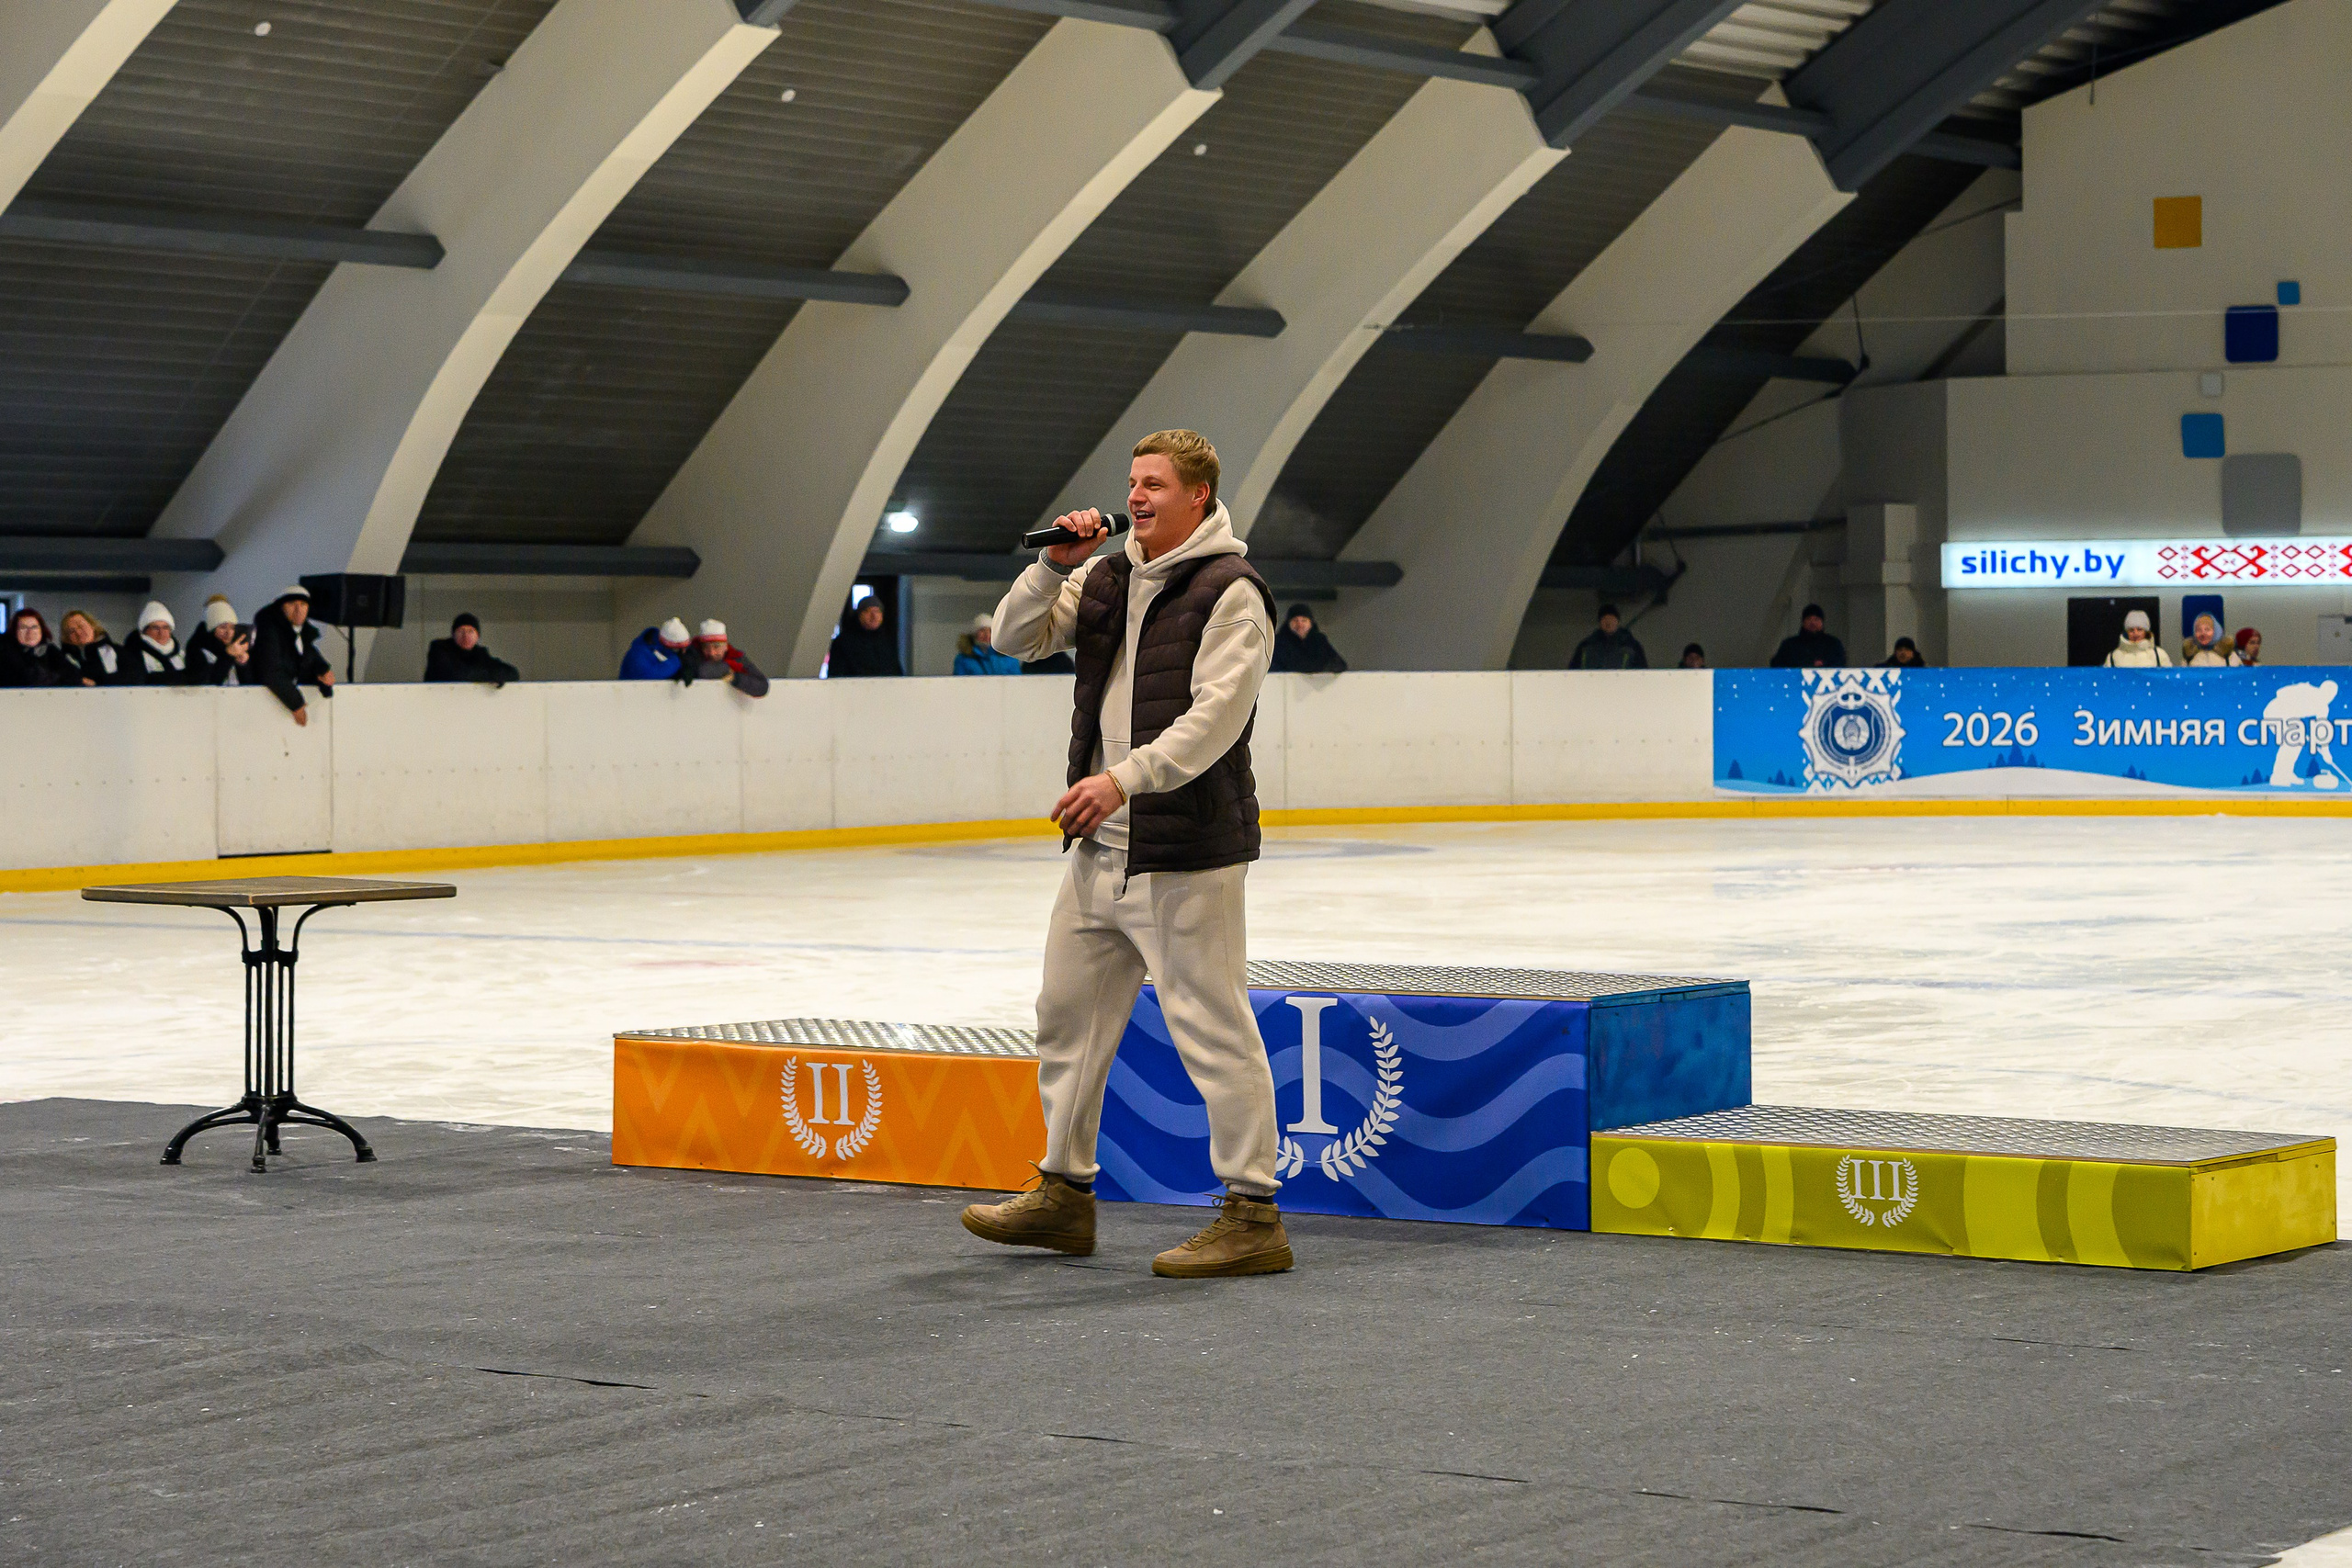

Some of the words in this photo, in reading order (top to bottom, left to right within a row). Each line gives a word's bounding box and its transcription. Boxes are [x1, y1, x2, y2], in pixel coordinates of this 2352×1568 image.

[1962, 548, 2125, 579] silichy.by
[1942, 711, 2039, 747] 2026
[2073, 709, 2225, 746] Зимняя
[2237, 717, 2352, 755] спарт
[1285, 996, 1339, 1134] I
[806, 1062, 855, 1125] II
[1849, 1159, 1906, 1201] III
